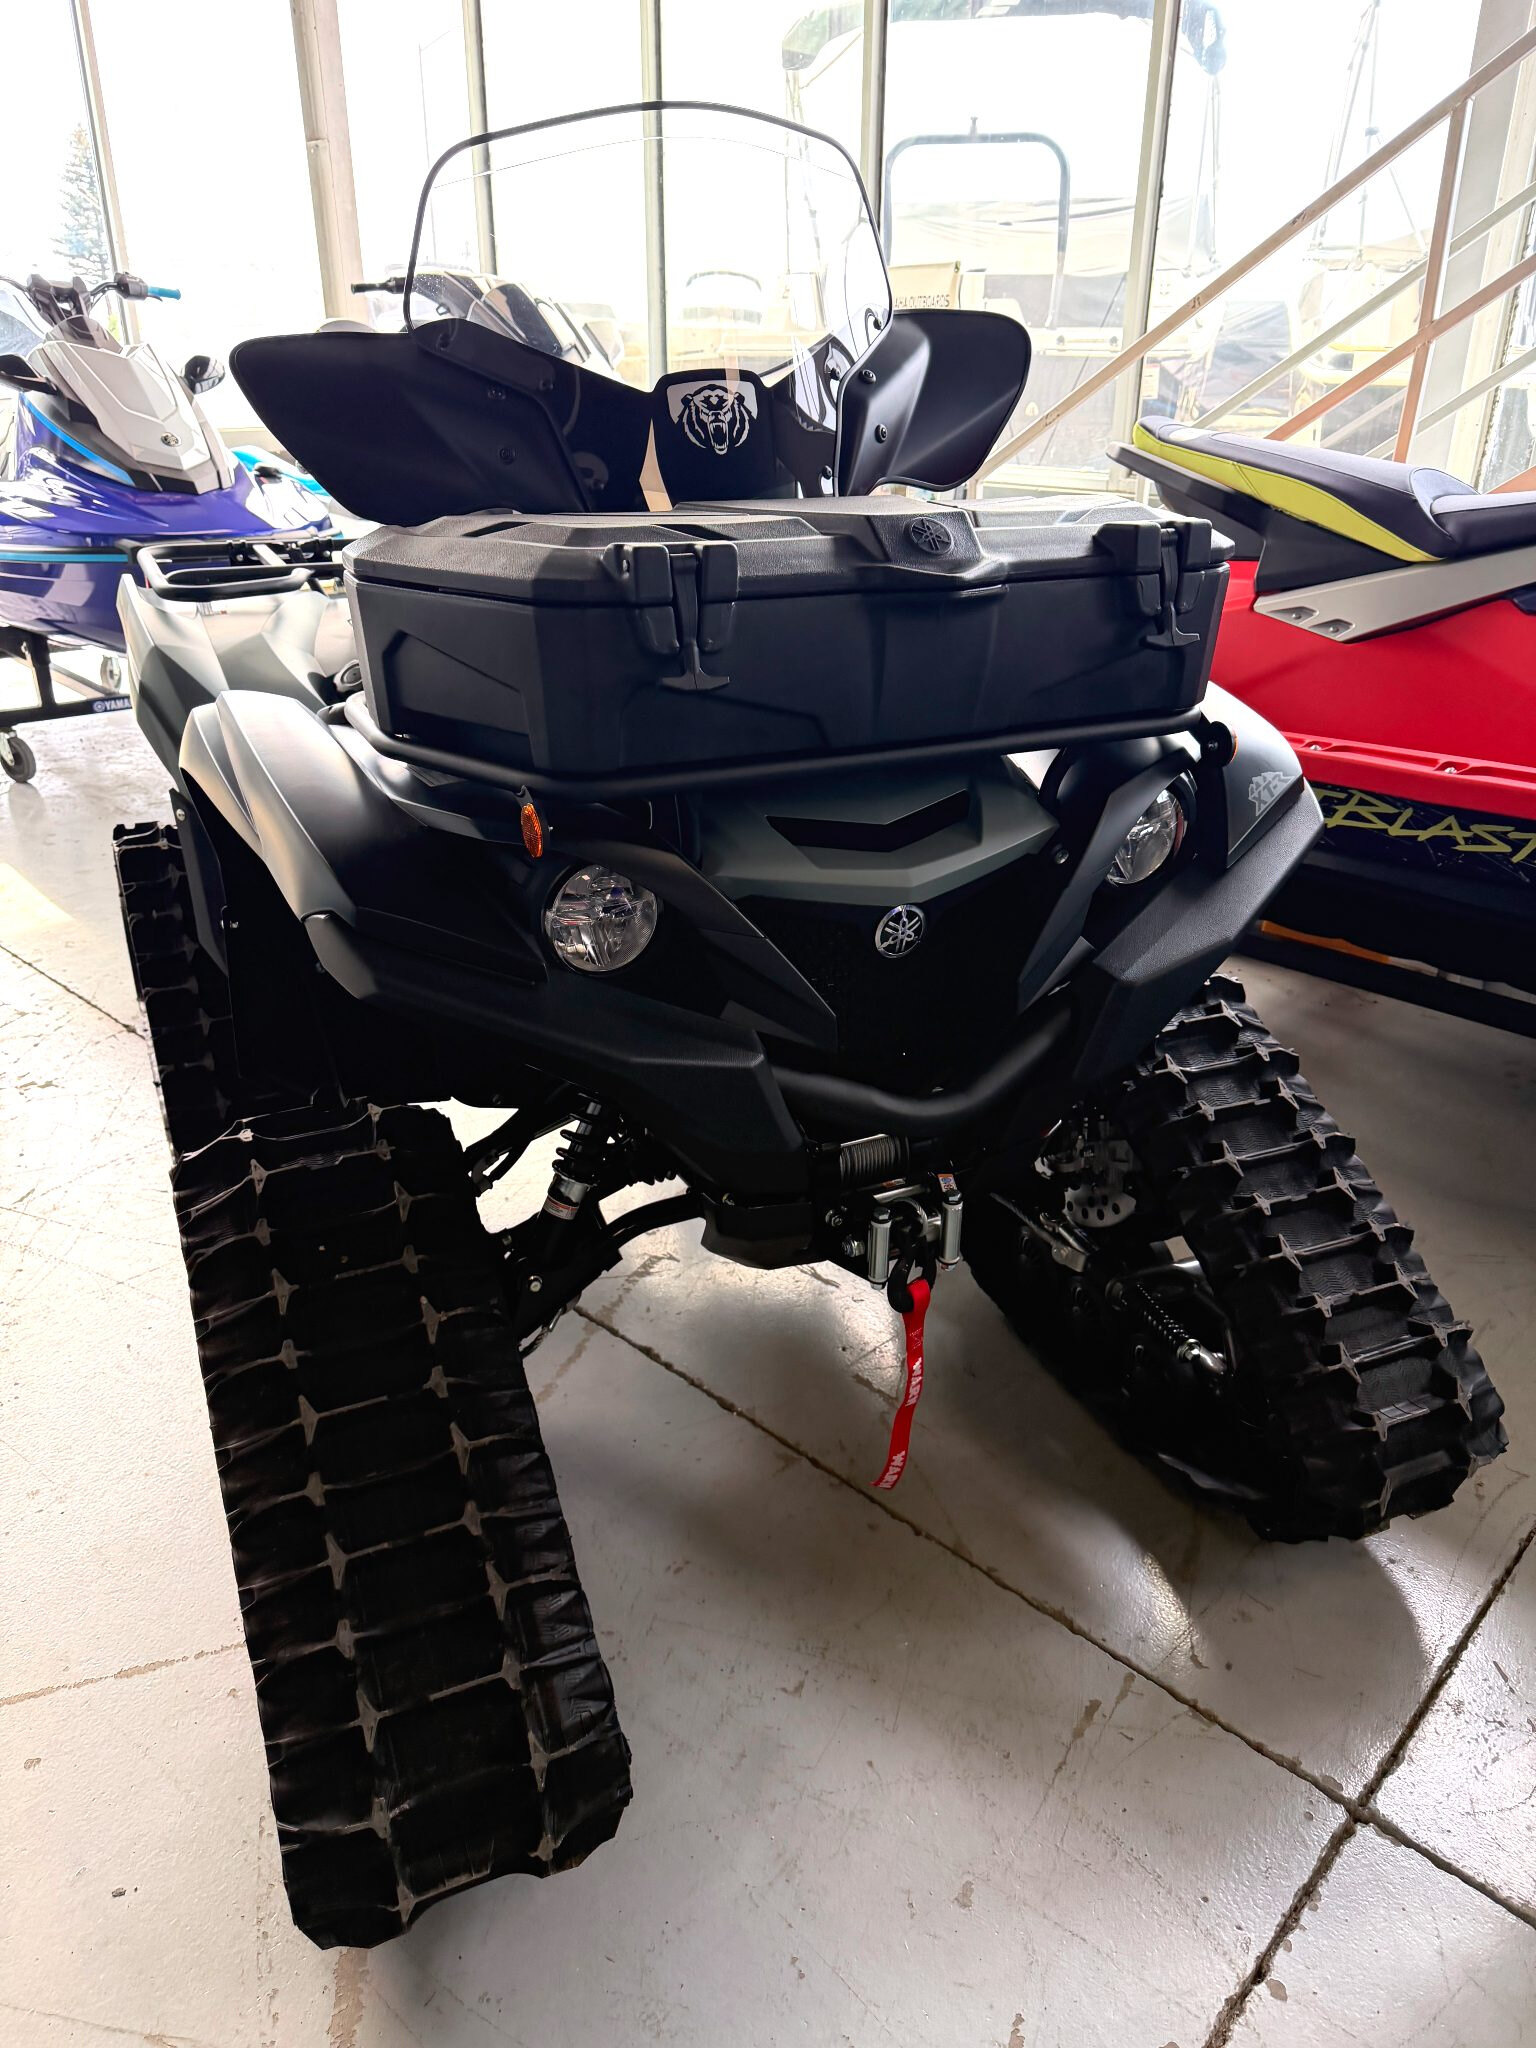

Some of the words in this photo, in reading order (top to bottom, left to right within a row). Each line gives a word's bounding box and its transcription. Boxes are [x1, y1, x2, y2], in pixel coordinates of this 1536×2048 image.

[909, 294, 950, 308] OUTBOARDS
[905, 1356, 923, 1407] WARN
[879, 1450, 906, 1489] WARN
